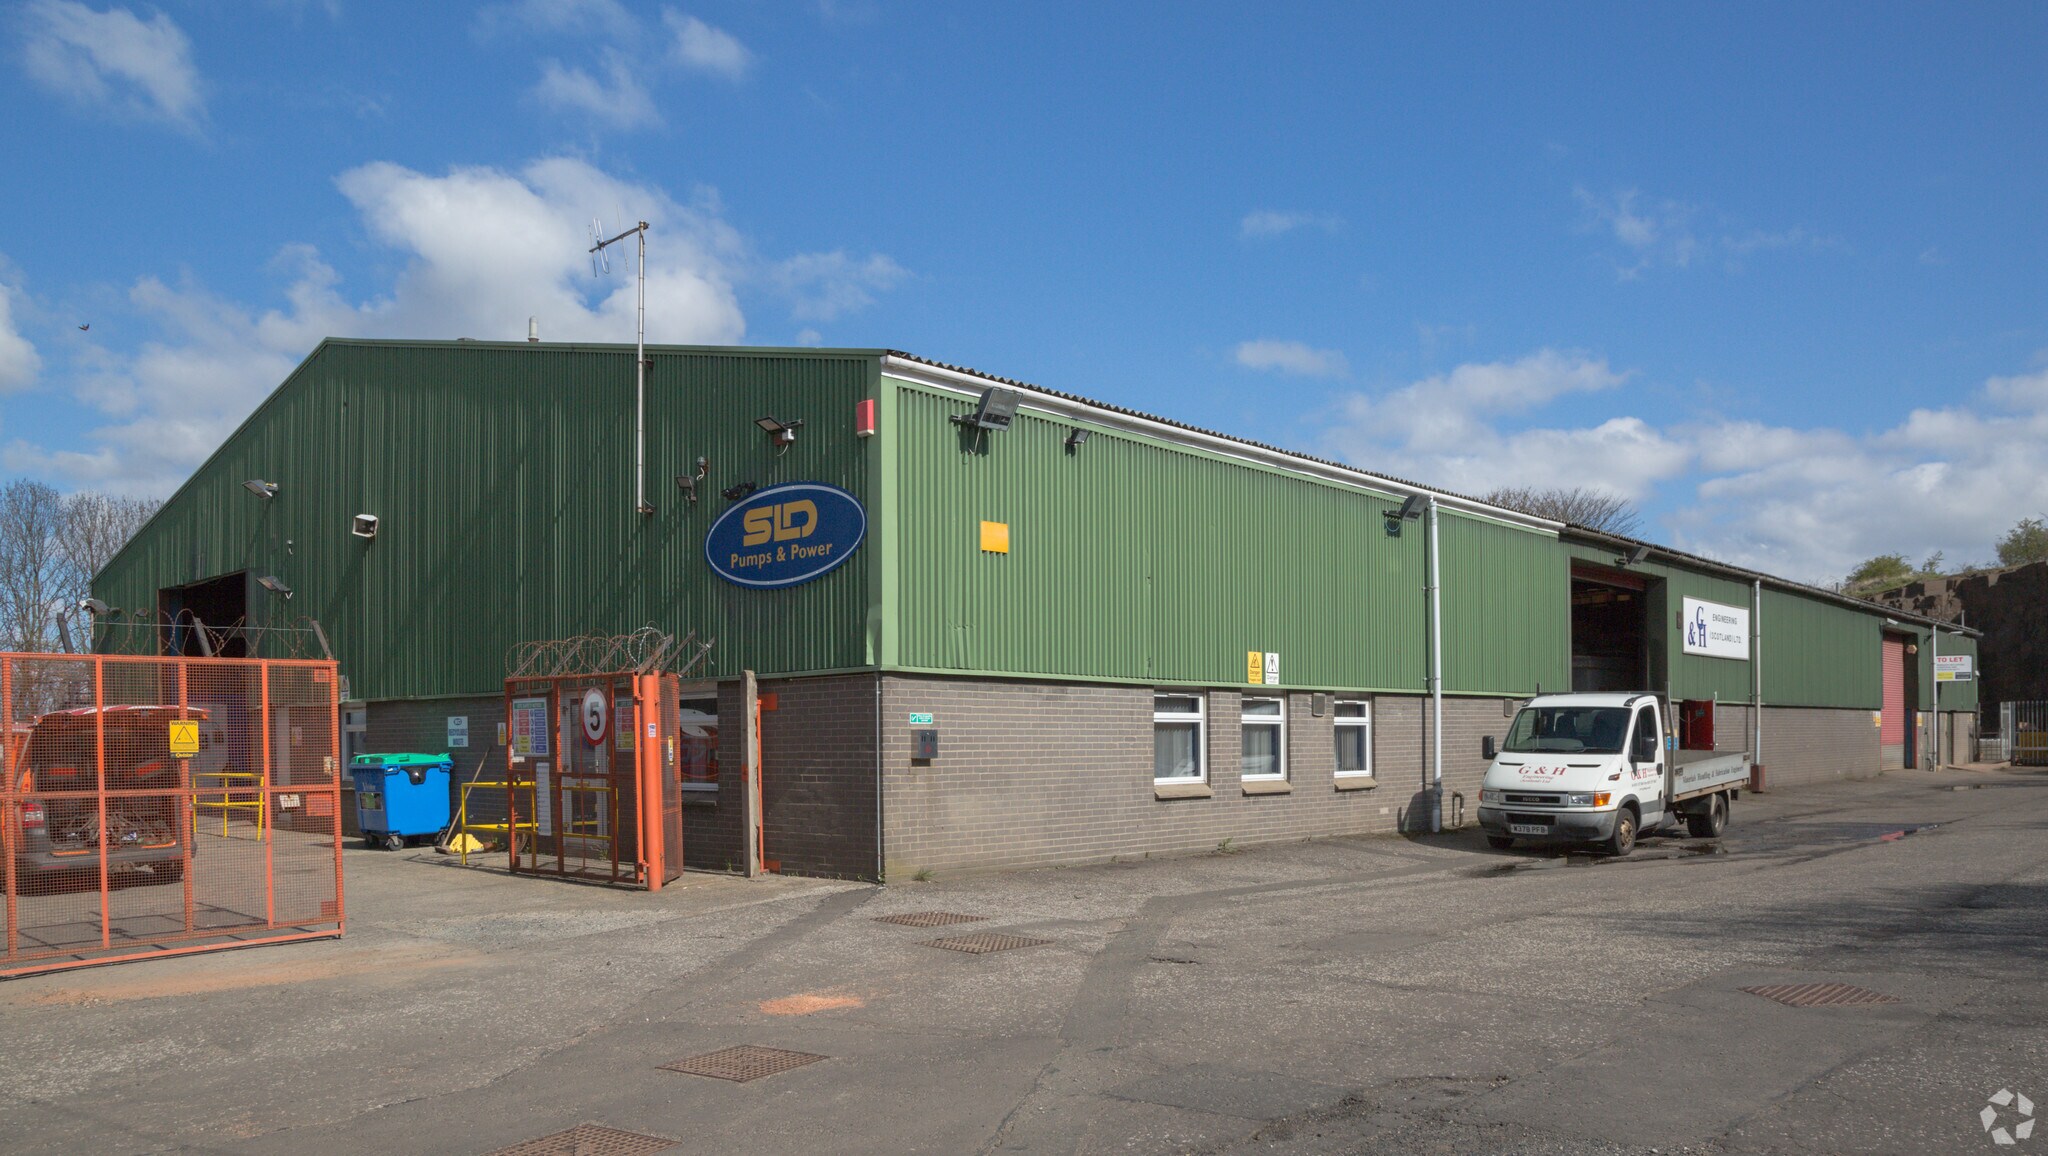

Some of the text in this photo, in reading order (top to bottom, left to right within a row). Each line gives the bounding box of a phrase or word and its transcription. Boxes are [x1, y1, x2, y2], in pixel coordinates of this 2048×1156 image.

[743, 499, 818, 547] SLD
[730, 543, 833, 569] Pumps & Power
[1696, 606, 1704, 630] G
[1712, 613, 1738, 625] ENGINEERING
[1688, 621, 1707, 648] & H
[589, 701, 601, 732] 5
[1518, 765, 1567, 776] G & H
[1637, 769, 1642, 779] &
[1642, 768, 1647, 779] H
